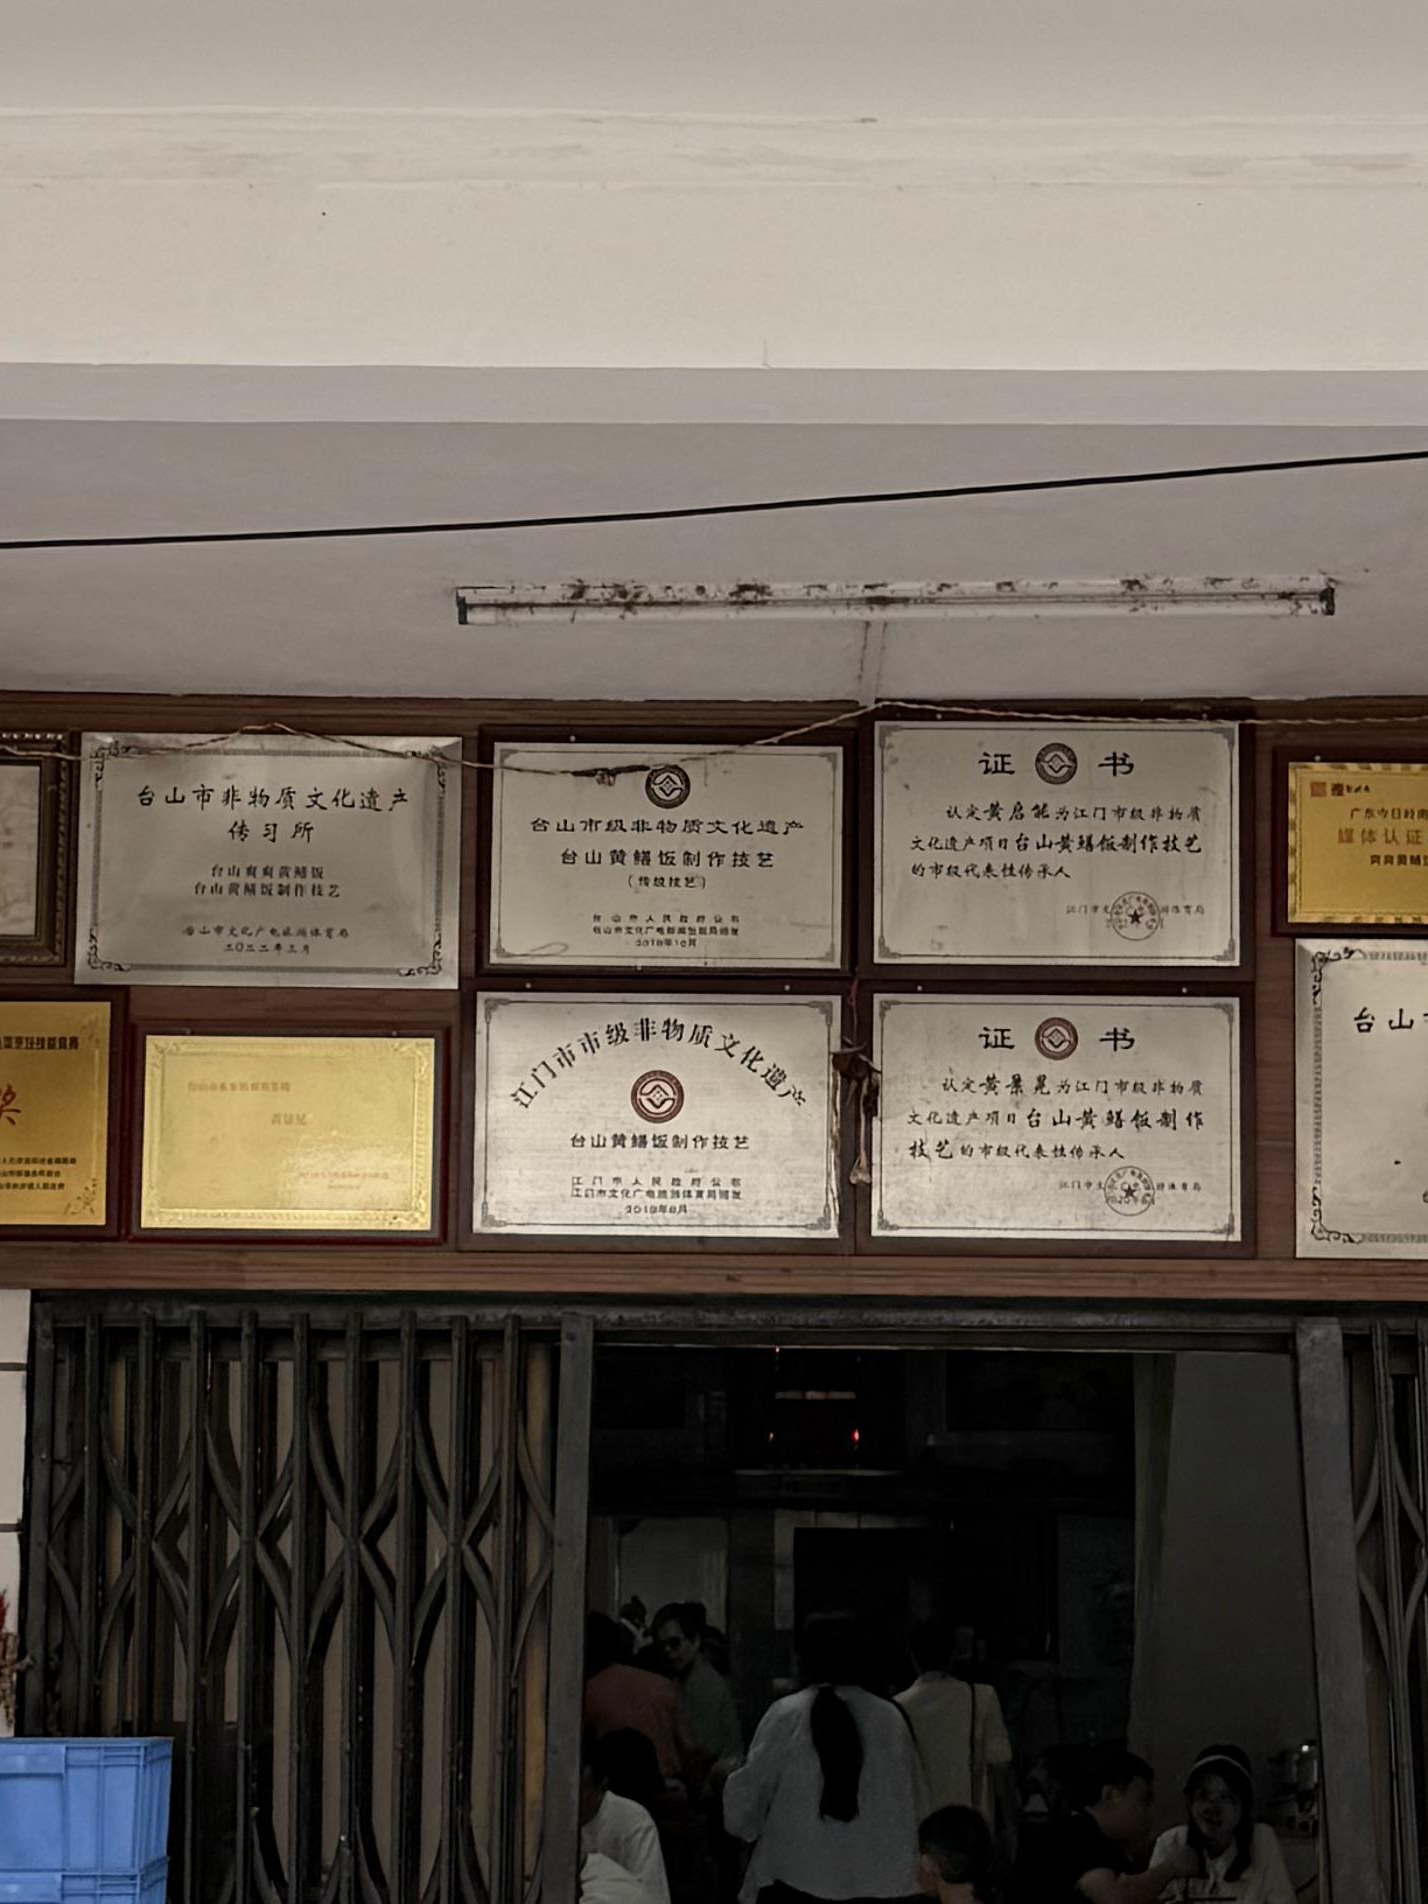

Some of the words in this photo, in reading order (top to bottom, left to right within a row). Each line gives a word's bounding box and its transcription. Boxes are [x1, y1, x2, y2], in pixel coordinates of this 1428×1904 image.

[977, 751, 1016, 776] 证
[1098, 751, 1135, 777] 书
[138, 782, 410, 813] 台山市非物质文化遗产
[227, 819, 316, 844] 传习所
[530, 816, 805, 837] 台山市级非物质文化遗产
[559, 847, 776, 869] 台山黄鳝饭制作技艺
[910, 862, 1071, 880] 的市级代表性传承人
[977, 1025, 1016, 1051] 证
[1099, 1025, 1136, 1053] 书
[510, 1017, 807, 1109] 江门市市级非物质文化遗产
[907, 1107, 1205, 1131] 文化遗产项目台山黄鳝饭制作
[570, 1133, 751, 1151] 台山黄鳝饭制作技艺
[908, 1138, 1126, 1160] 技艺的市级代表性传承人
